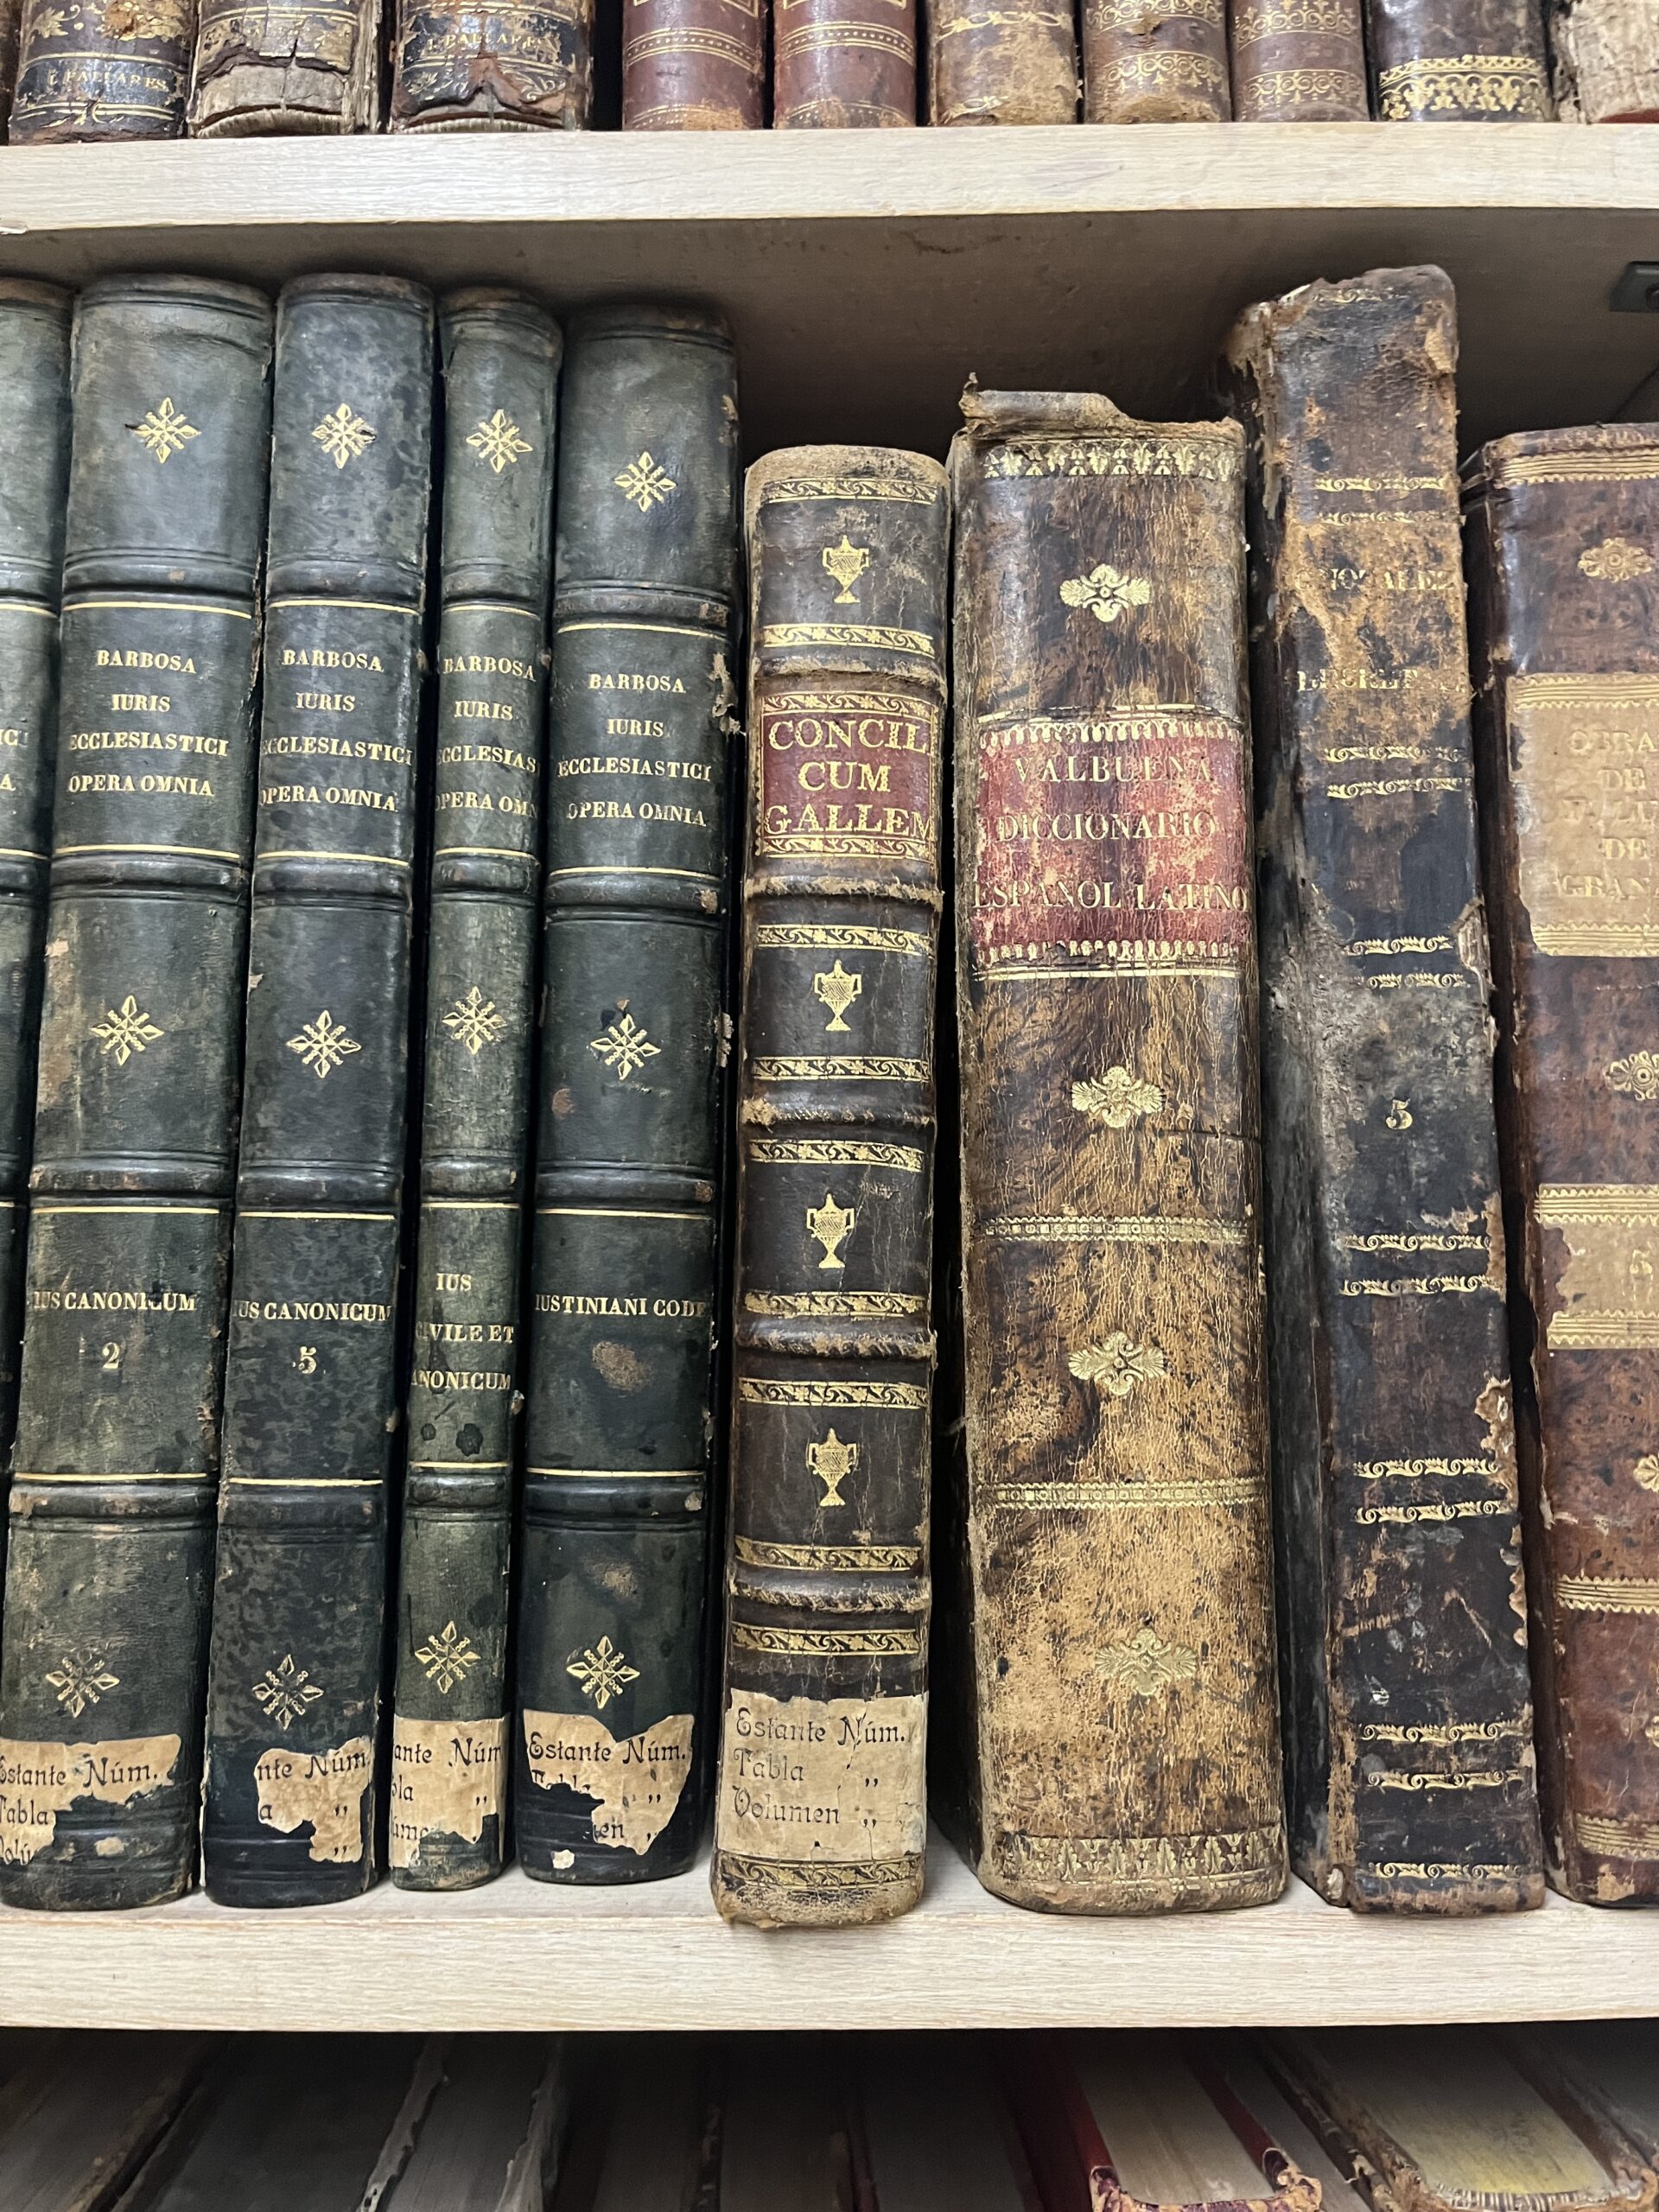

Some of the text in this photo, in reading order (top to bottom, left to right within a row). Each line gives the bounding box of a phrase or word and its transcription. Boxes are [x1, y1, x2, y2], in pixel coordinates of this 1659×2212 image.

[97, 650, 196, 674] BARBOSA
[282, 649, 385, 673] BARBOSA
[443, 655, 537, 682] BARBOSA
[588, 673, 686, 693] BARBOSA
[111, 694, 171, 712] IURIS
[296, 692, 355, 712] IURIS
[454, 701, 513, 721] IURIS
[607, 718, 664, 737] IURIS
[69, 732, 228, 756] ECCLESIASTICI
[557, 756, 712, 782] ECCLESIASTICI
[798, 760, 891, 793] CUM
[1015, 755, 1213, 784] VALBUENA
[68, 774, 214, 797] OPERA OMNIA
[326, 787, 398, 812] OMNIA
[567, 802, 707, 827] OPERA OMNIA
[996, 810, 1217, 844] DICCIONARIO
[1134, 882, 1249, 912] LATINO
[1385, 1098, 1414, 1130] 5
[435, 1273, 472, 1291] IUS
[33, 1291, 61, 1309] IUS
[264, 1302, 393, 1322] CANONICUM
[535, 1294, 647, 1315] IUSTINIANI
[488, 1325, 514, 1344] ET
[102, 1342, 121, 1370] 2
[298, 1345, 317, 1375] 5
[411, 1369, 512, 1390] ANONICUM
[736, 1707, 906, 1746] Estante Núm.
[529, 1731, 687, 1764] Estante Núm.
[82, 1753, 158, 1788] Núm.
[734, 1747, 804, 1782] Tabla
